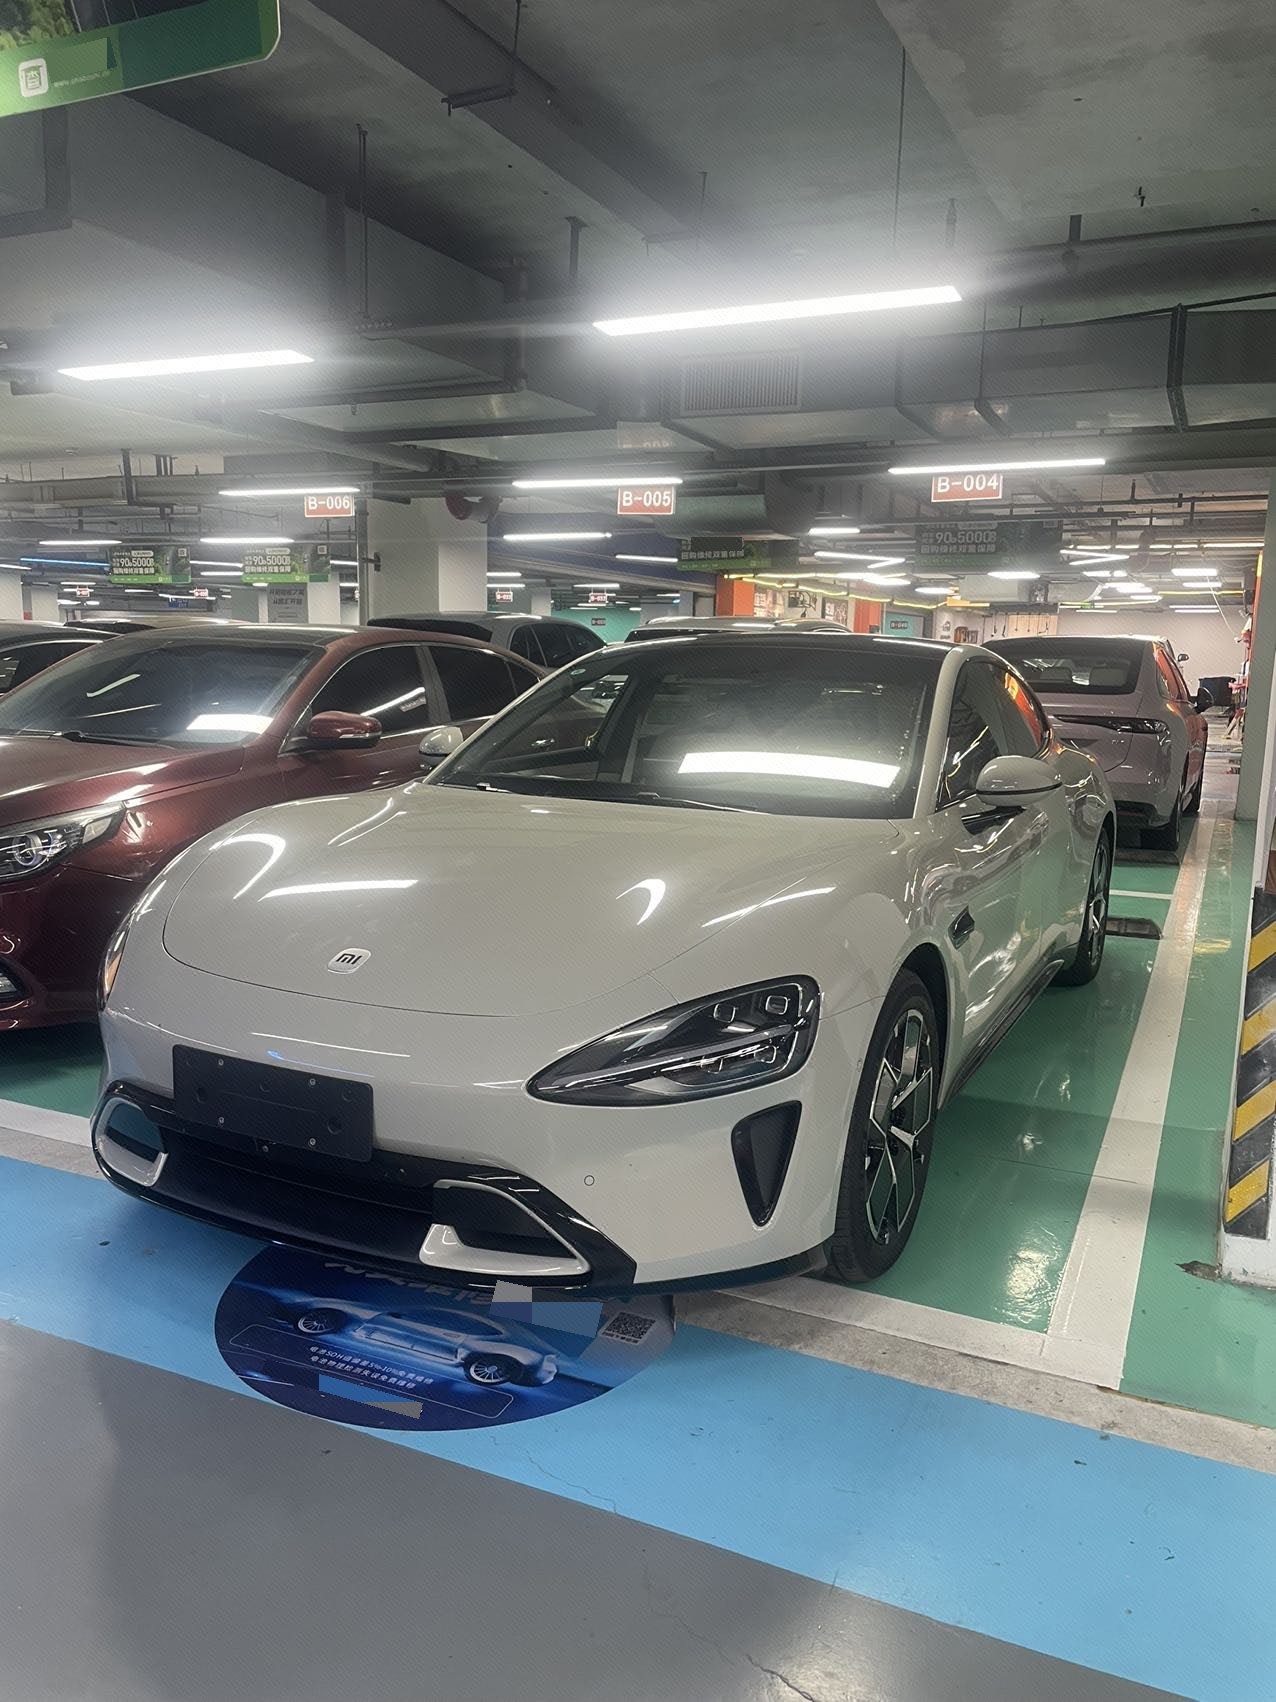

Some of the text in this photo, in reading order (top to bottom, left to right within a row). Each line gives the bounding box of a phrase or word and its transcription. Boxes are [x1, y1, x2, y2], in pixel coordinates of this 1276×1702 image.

[937, 473, 999, 493] B-004
[308, 495, 350, 509] B-006
[622, 490, 671, 507] B-005
[336, 953, 362, 964] MI
